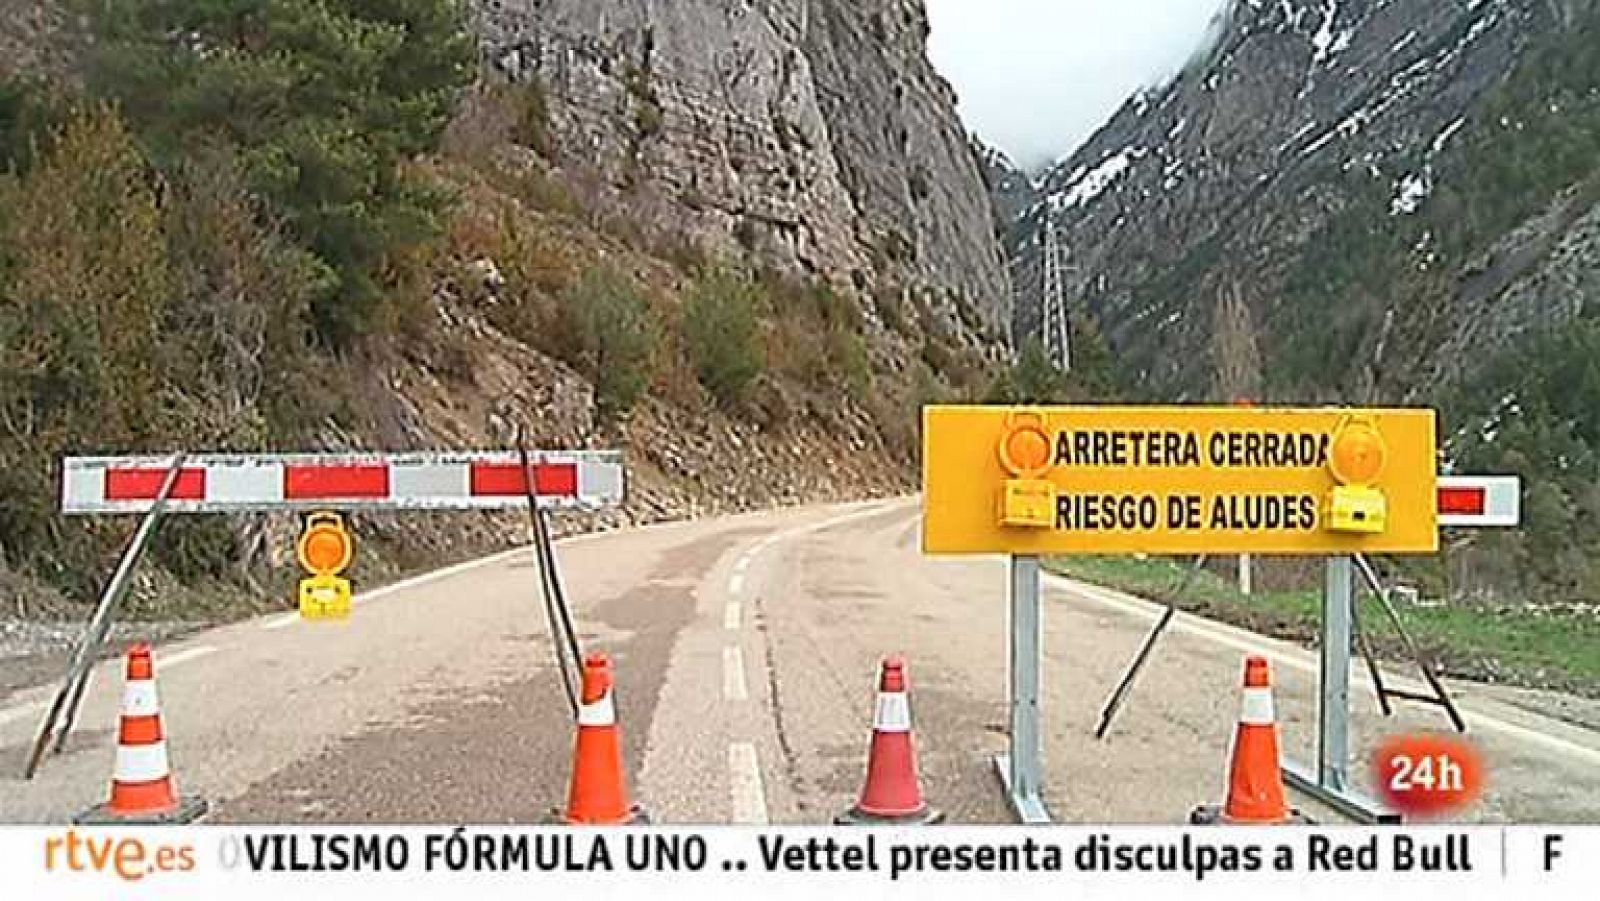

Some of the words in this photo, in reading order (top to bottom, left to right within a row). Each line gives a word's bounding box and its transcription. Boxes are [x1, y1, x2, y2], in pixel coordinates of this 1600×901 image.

[1054, 431, 1200, 466] ARRETERA
[1055, 494, 1157, 530] RIESGO
[1167, 495, 1201, 529] DE
[1210, 495, 1315, 529] ALUDES
